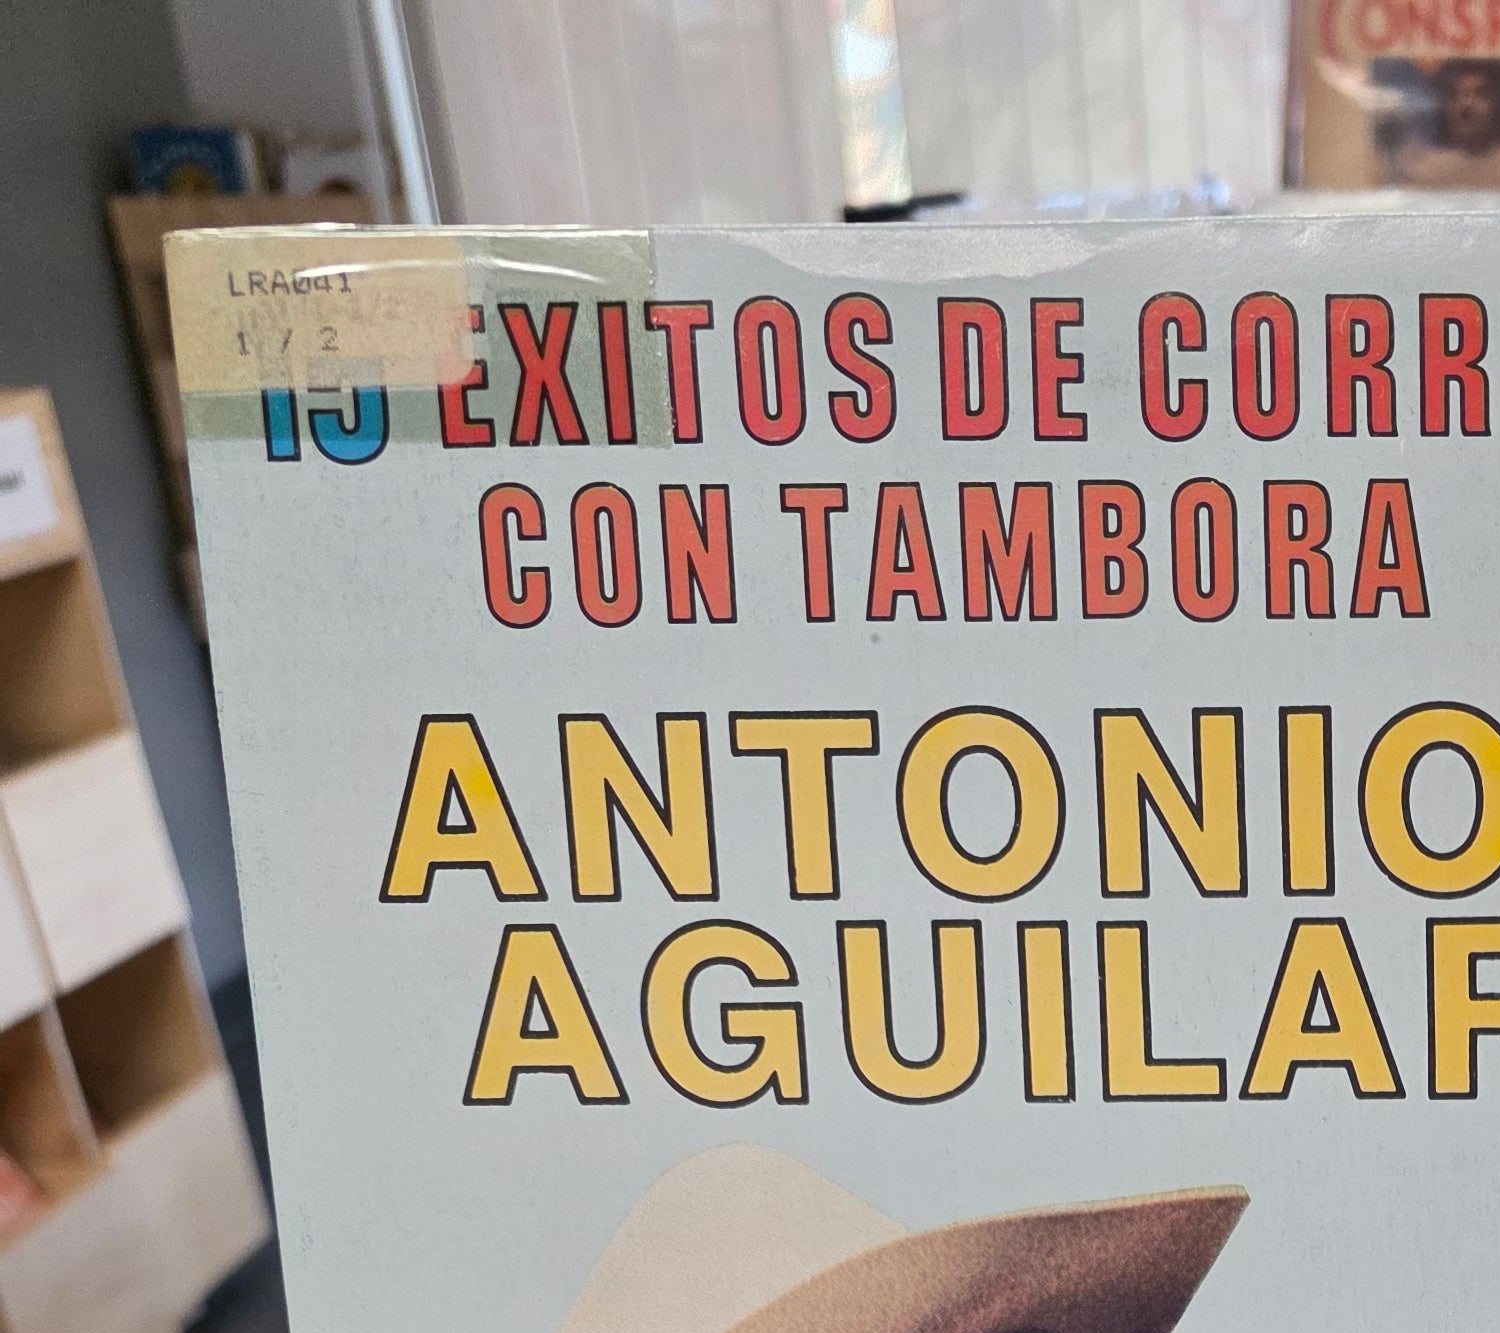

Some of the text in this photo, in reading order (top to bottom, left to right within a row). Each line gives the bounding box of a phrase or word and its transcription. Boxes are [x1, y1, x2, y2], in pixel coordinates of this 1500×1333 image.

[436, 292, 897, 450] EXITOS
[940, 294, 1088, 443] DE
[478, 476, 1431, 629] CON TAMBORA
